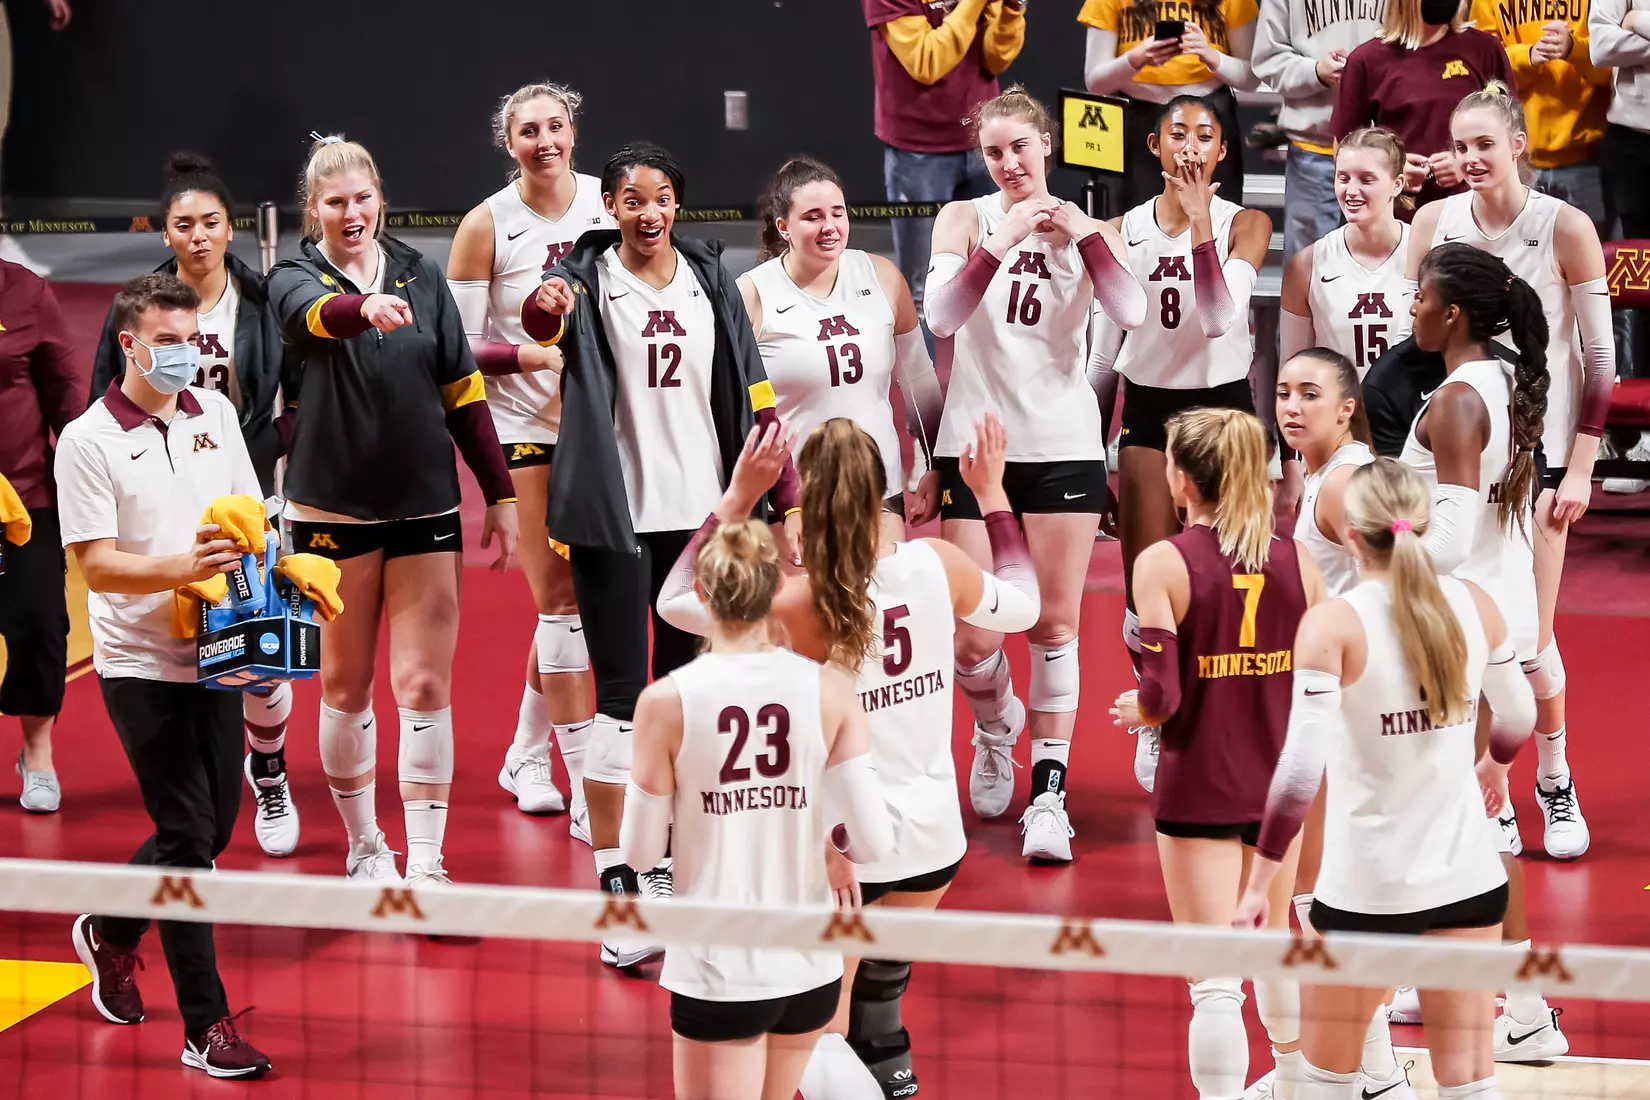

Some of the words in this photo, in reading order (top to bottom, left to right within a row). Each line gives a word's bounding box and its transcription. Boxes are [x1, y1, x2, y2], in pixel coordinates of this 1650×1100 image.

[1078, 104, 1109, 132] M
[1085, 142, 1095, 151] PR
[1097, 144, 1102, 152] 1
[848, 205, 915, 217] NIVERSITY
[918, 206, 934, 216] OF
[11, 222, 26, 232] OF
[29, 219, 97, 233] MINNESOTA
[1008, 251, 1052, 280] M
[1149, 255, 1192, 281] M
[1006, 280, 1042, 326] 16
[1160, 287, 1182, 330] 8
[1348, 293, 1393, 319] M
[641, 310, 687, 338] M
[817, 314, 860, 341] M
[1354, 324, 1389, 368] 15
[648, 343, 682, 388] 12
[826, 343, 864, 387] 13
[192, 432, 218, 453] M
[309, 532, 340, 549] M
[1232, 574, 1265, 648] 7
[199, 634, 246, 660] POWERADE
[883, 604, 912, 677] 5
[1198, 650, 1292, 679] MINNESOTA
[857, 669, 945, 713] INNESOTA
[717, 703, 790, 785] 23
[701, 785, 807, 815] MINNESOTA
